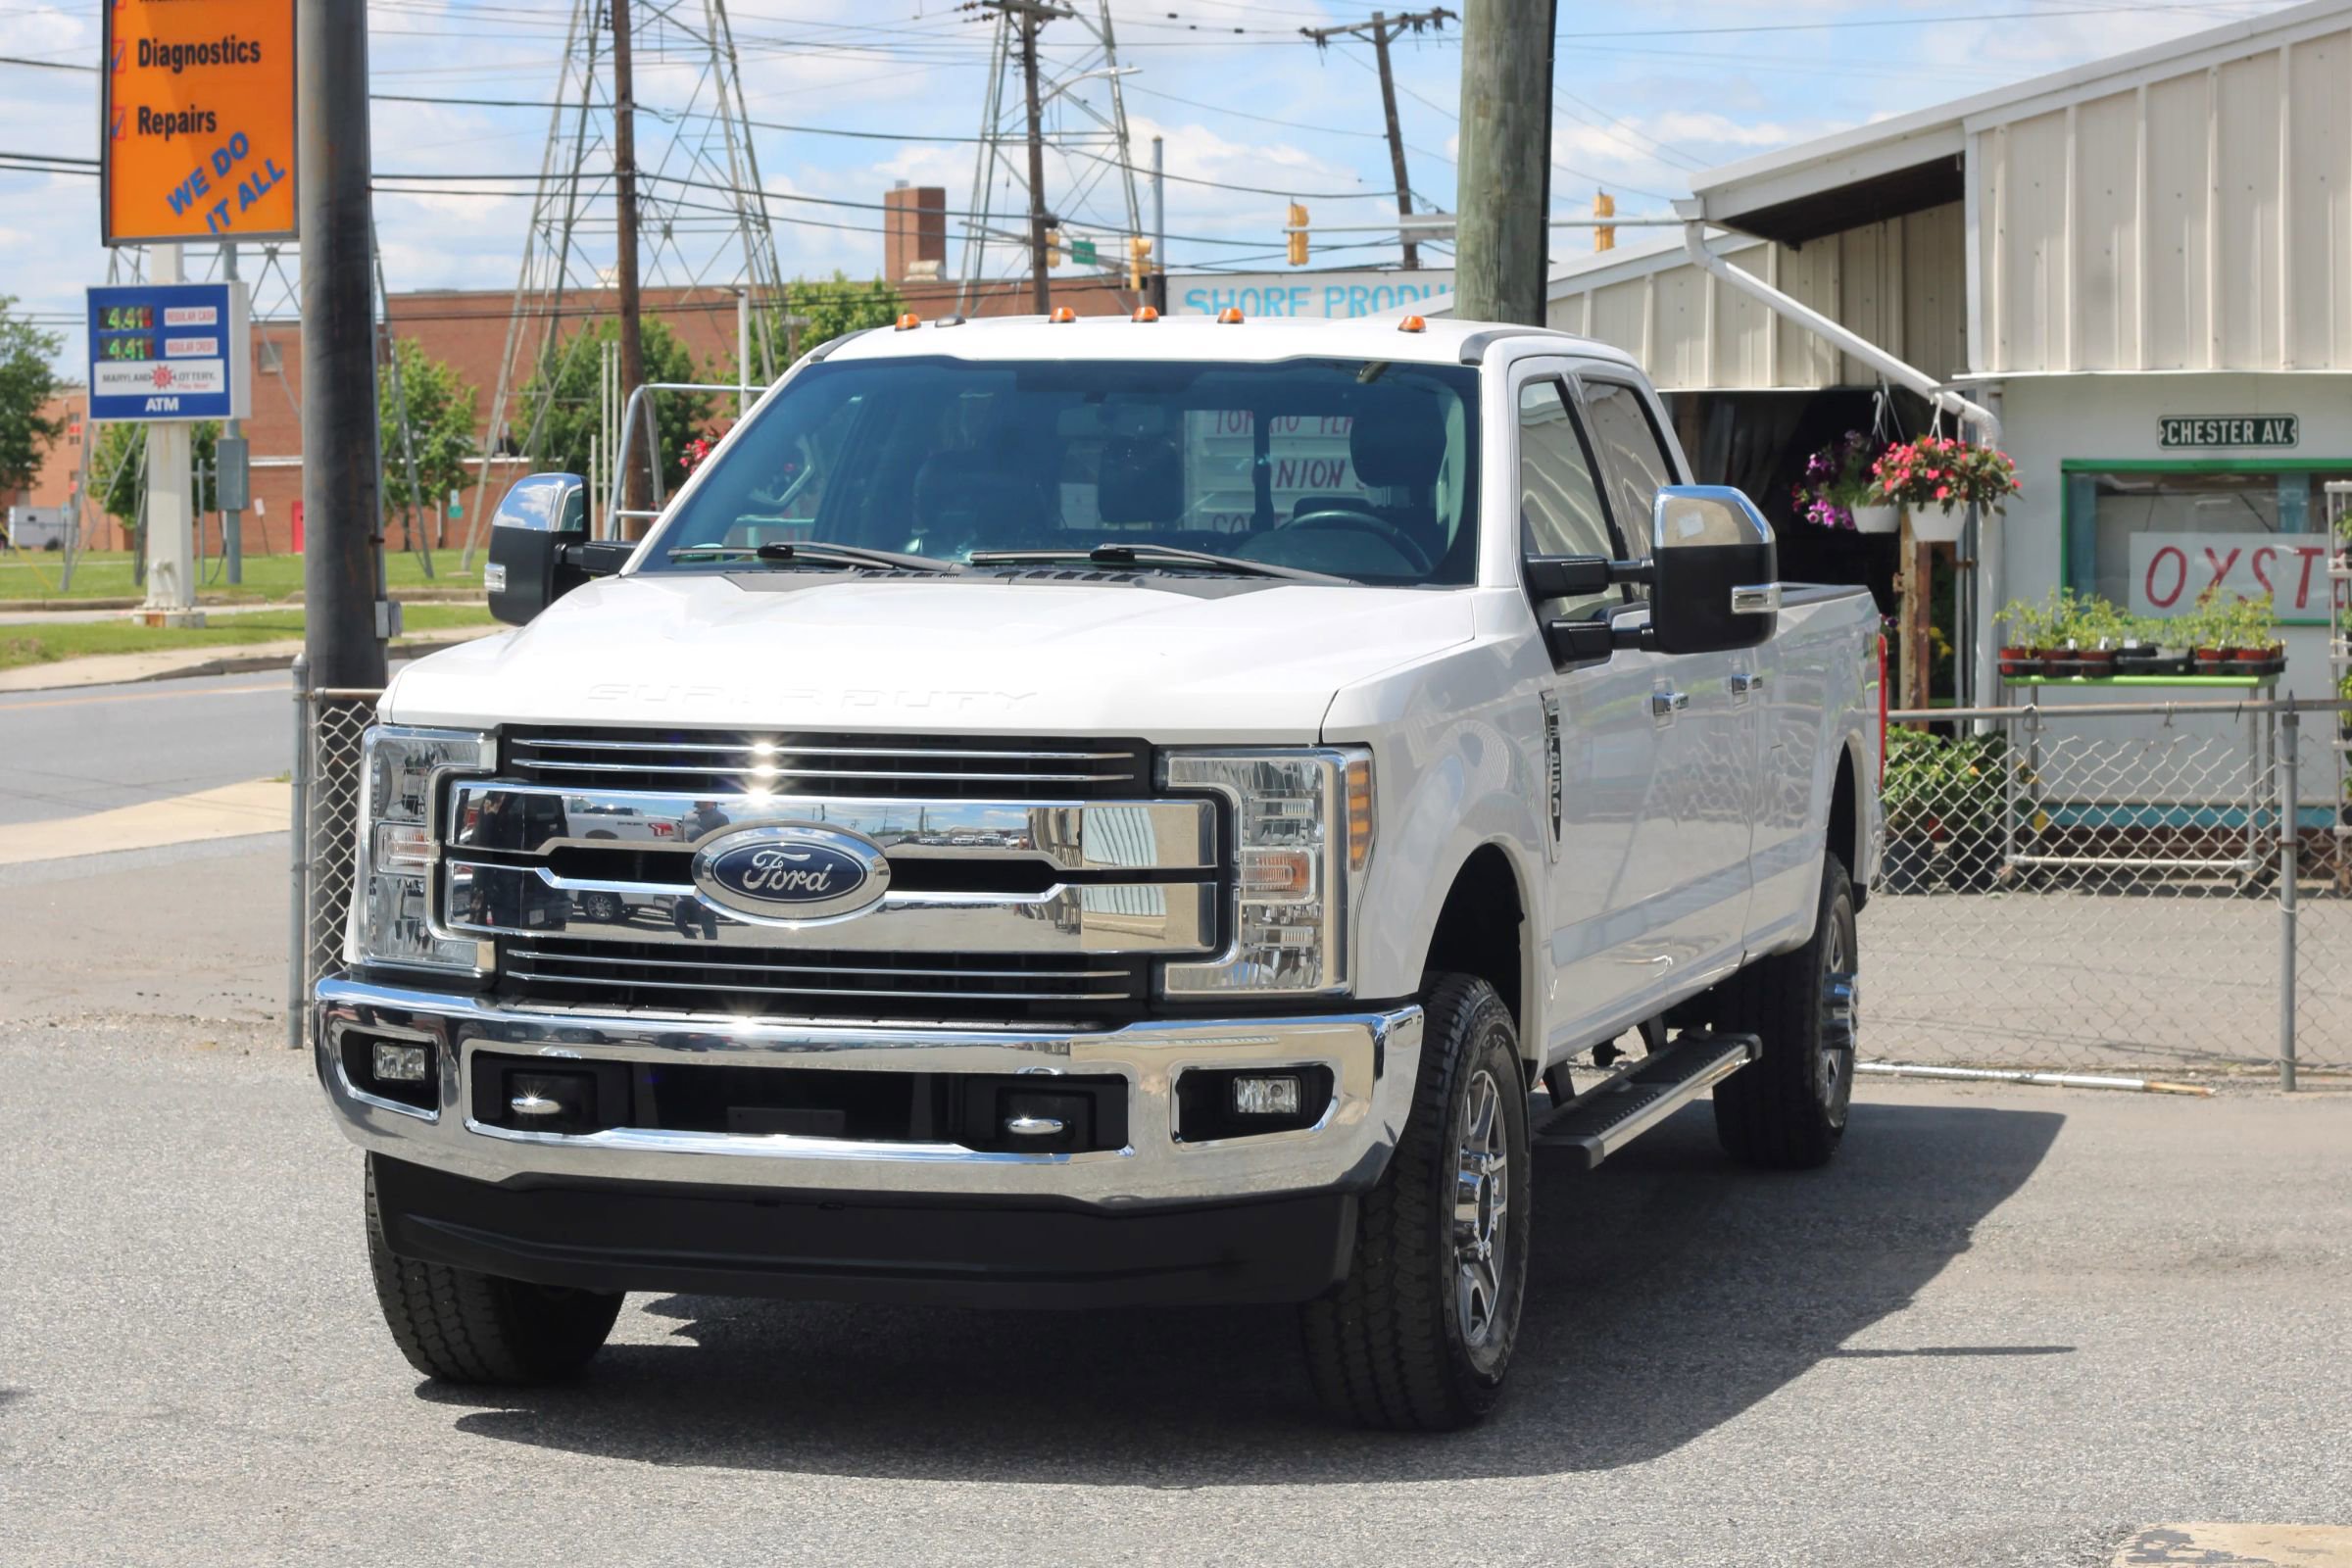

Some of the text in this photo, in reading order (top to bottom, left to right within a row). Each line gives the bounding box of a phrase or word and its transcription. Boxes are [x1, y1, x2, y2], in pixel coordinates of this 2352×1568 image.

[138, 34, 261, 74] Diagnostics
[137, 104, 217, 141] Repairs
[166, 131, 249, 217] WE DO
[205, 158, 286, 235] IT ALL
[1184, 285, 1312, 318] SHORE
[145, 397, 179, 412] ATM
[2167, 419, 2289, 444] CHESTER AV.
[742, 850, 831, 893] Ford
